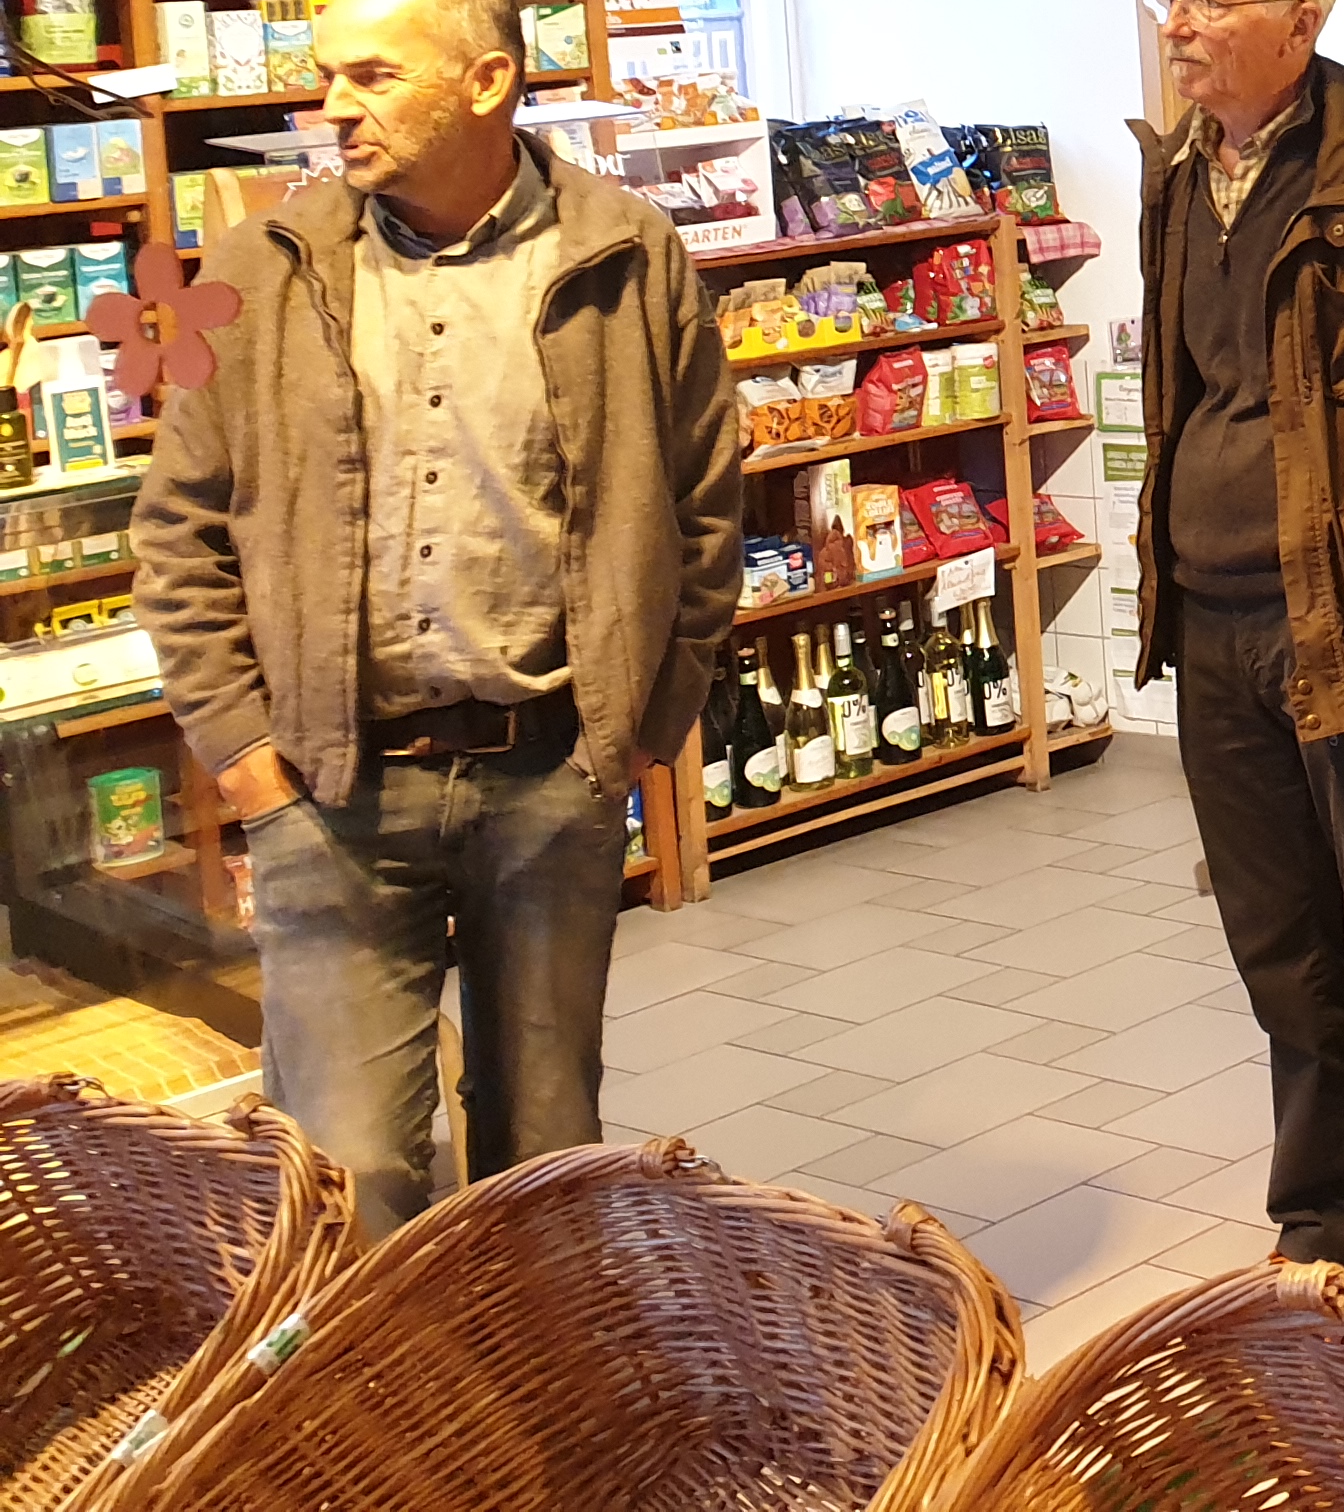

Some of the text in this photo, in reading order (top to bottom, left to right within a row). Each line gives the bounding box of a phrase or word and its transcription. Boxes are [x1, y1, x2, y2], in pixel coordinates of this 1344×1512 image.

[681, 224, 743, 246] GARTEN
[984, 680, 1008, 700] 0%
[843, 698, 867, 718] 0%
